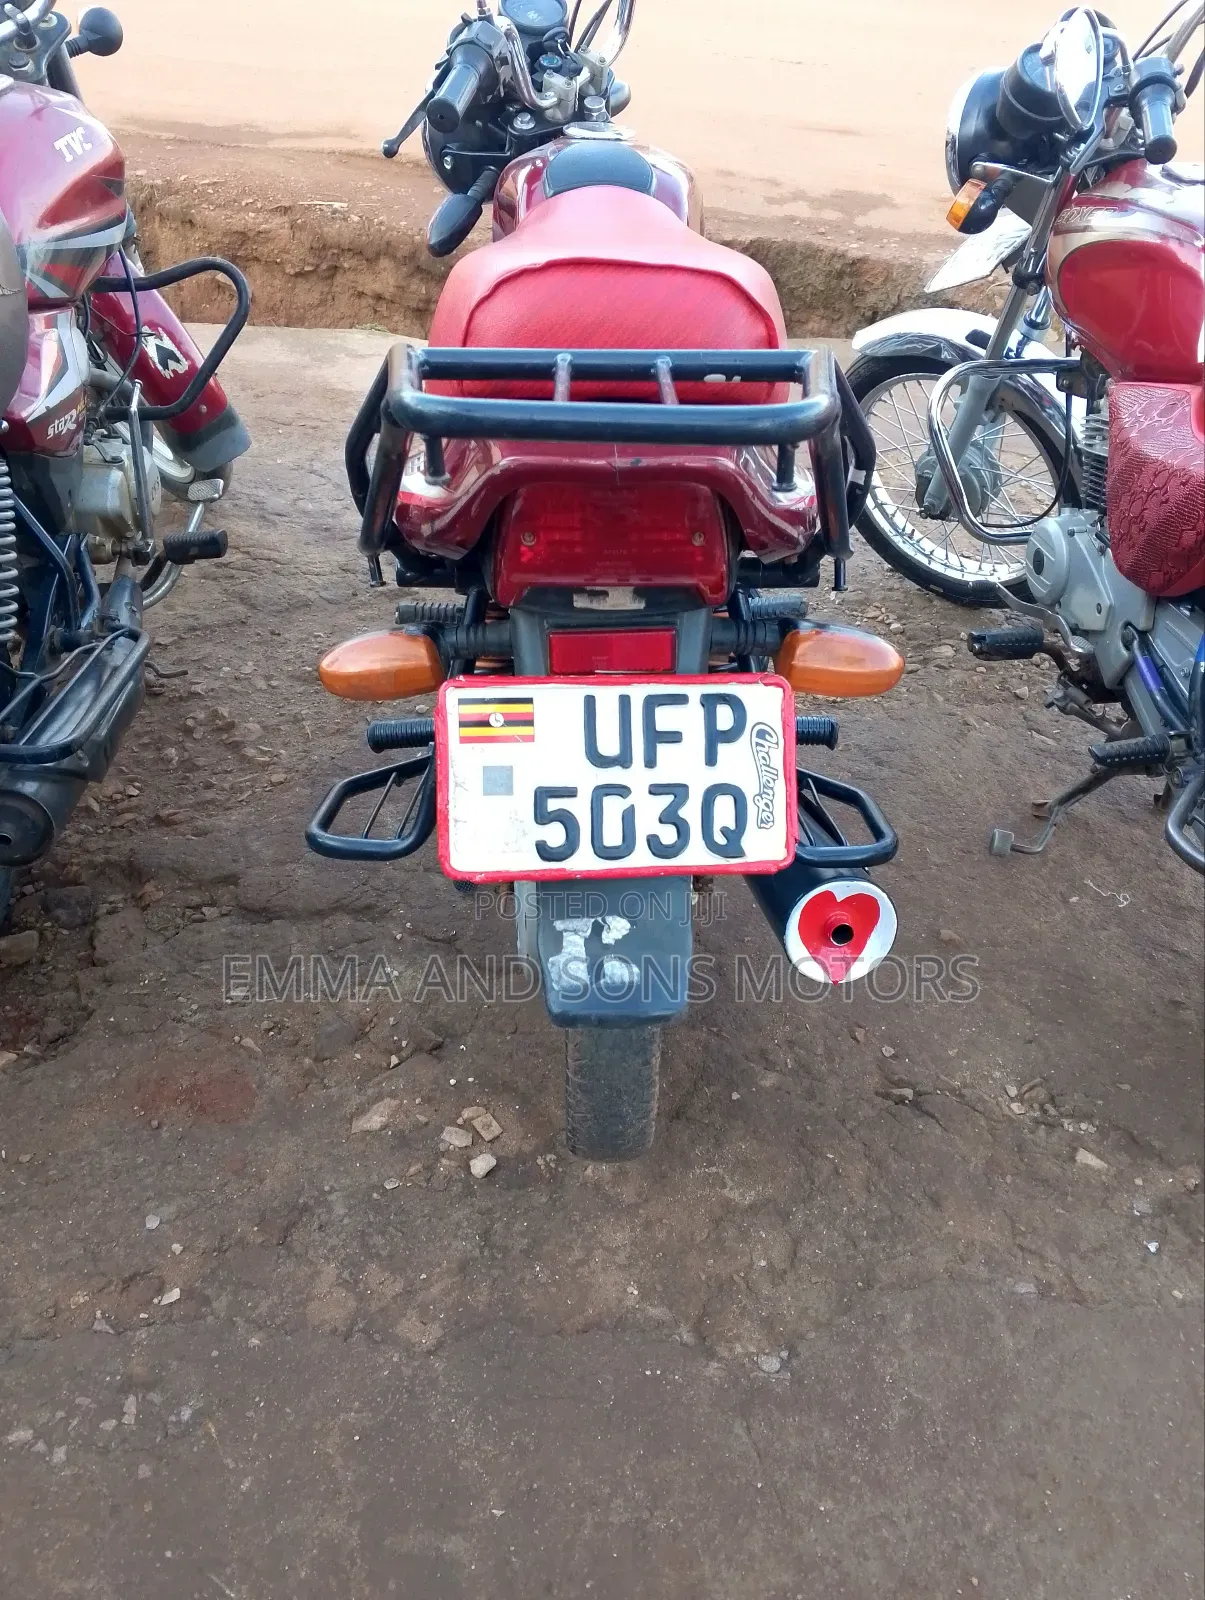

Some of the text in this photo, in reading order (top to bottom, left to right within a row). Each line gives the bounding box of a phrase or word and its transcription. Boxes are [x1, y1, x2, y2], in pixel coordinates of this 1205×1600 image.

[583, 692, 748, 769] UFP
[750, 721, 779, 829] Challenger
[533, 783, 748, 862] 503Q
